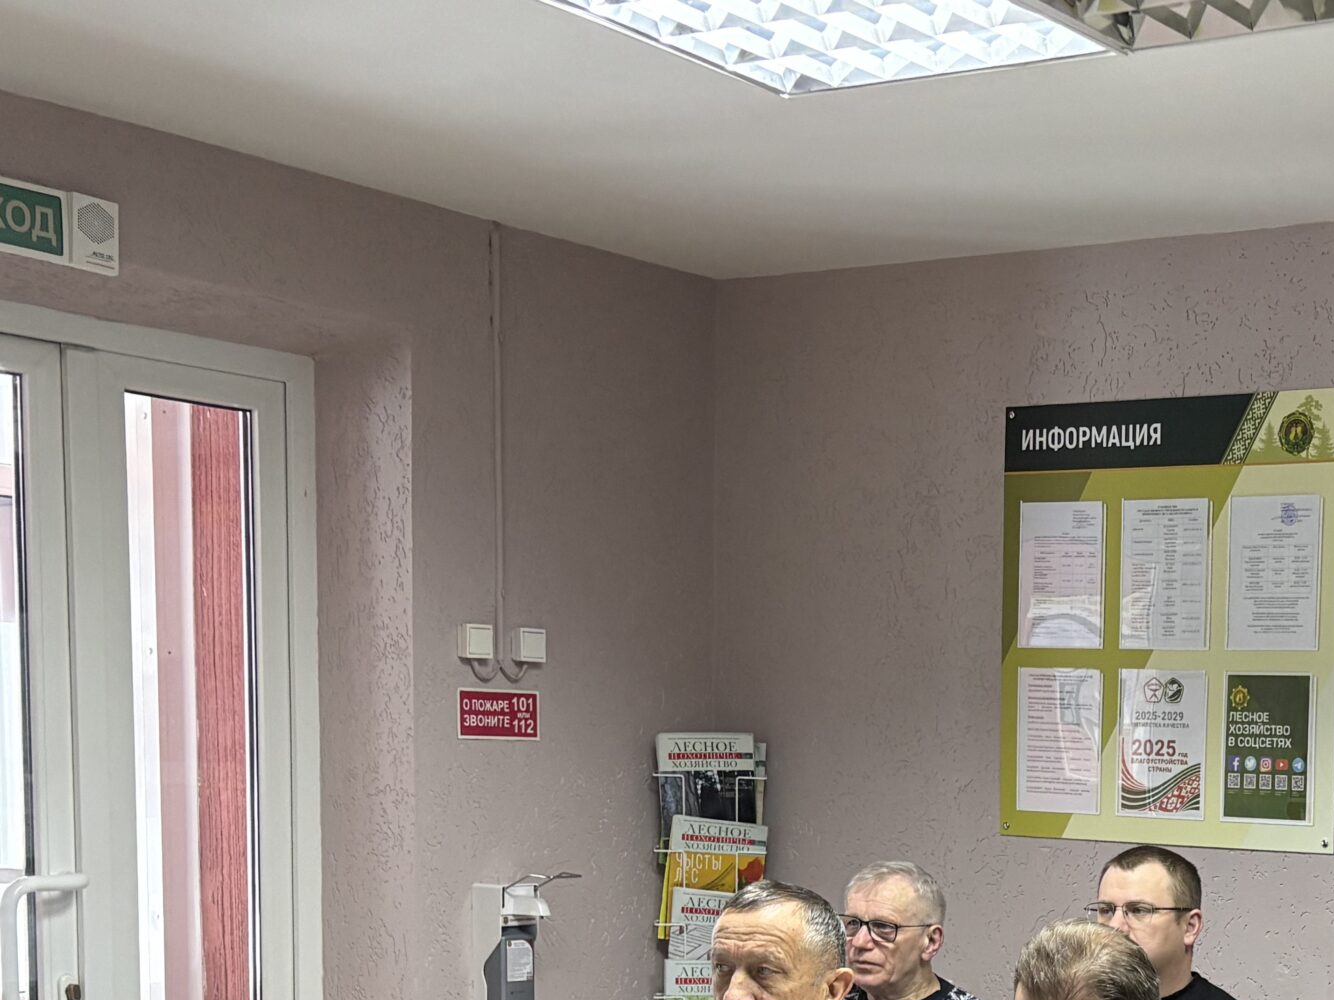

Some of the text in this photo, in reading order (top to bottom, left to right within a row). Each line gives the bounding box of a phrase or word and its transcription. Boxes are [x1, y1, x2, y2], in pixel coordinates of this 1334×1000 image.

[1021, 423, 1162, 451] ИНФОРМАЦИЯ
[462, 696, 533, 712] О ПОЖАРЕ 101
[1135, 711, 1184, 721] 2025-2029
[1229, 711, 1270, 722] ЛЕСНОЕ
[463, 714, 534, 734] ЗВОНИТЕ 112
[1228, 723, 1291, 736] ХОЗЯЙСТВО
[670, 741, 738, 752] ЛЕСНОЕ
[1131, 739, 1176, 757] 2025
[1228, 736, 1292, 749] В СОЦСЕТЯХ
[671, 760, 738, 768] ХОЗЯЙСТВО
[686, 823, 752, 838] ЛЕСНОЕ
[684, 842, 750, 852] ХОЗЯЙСТВО
